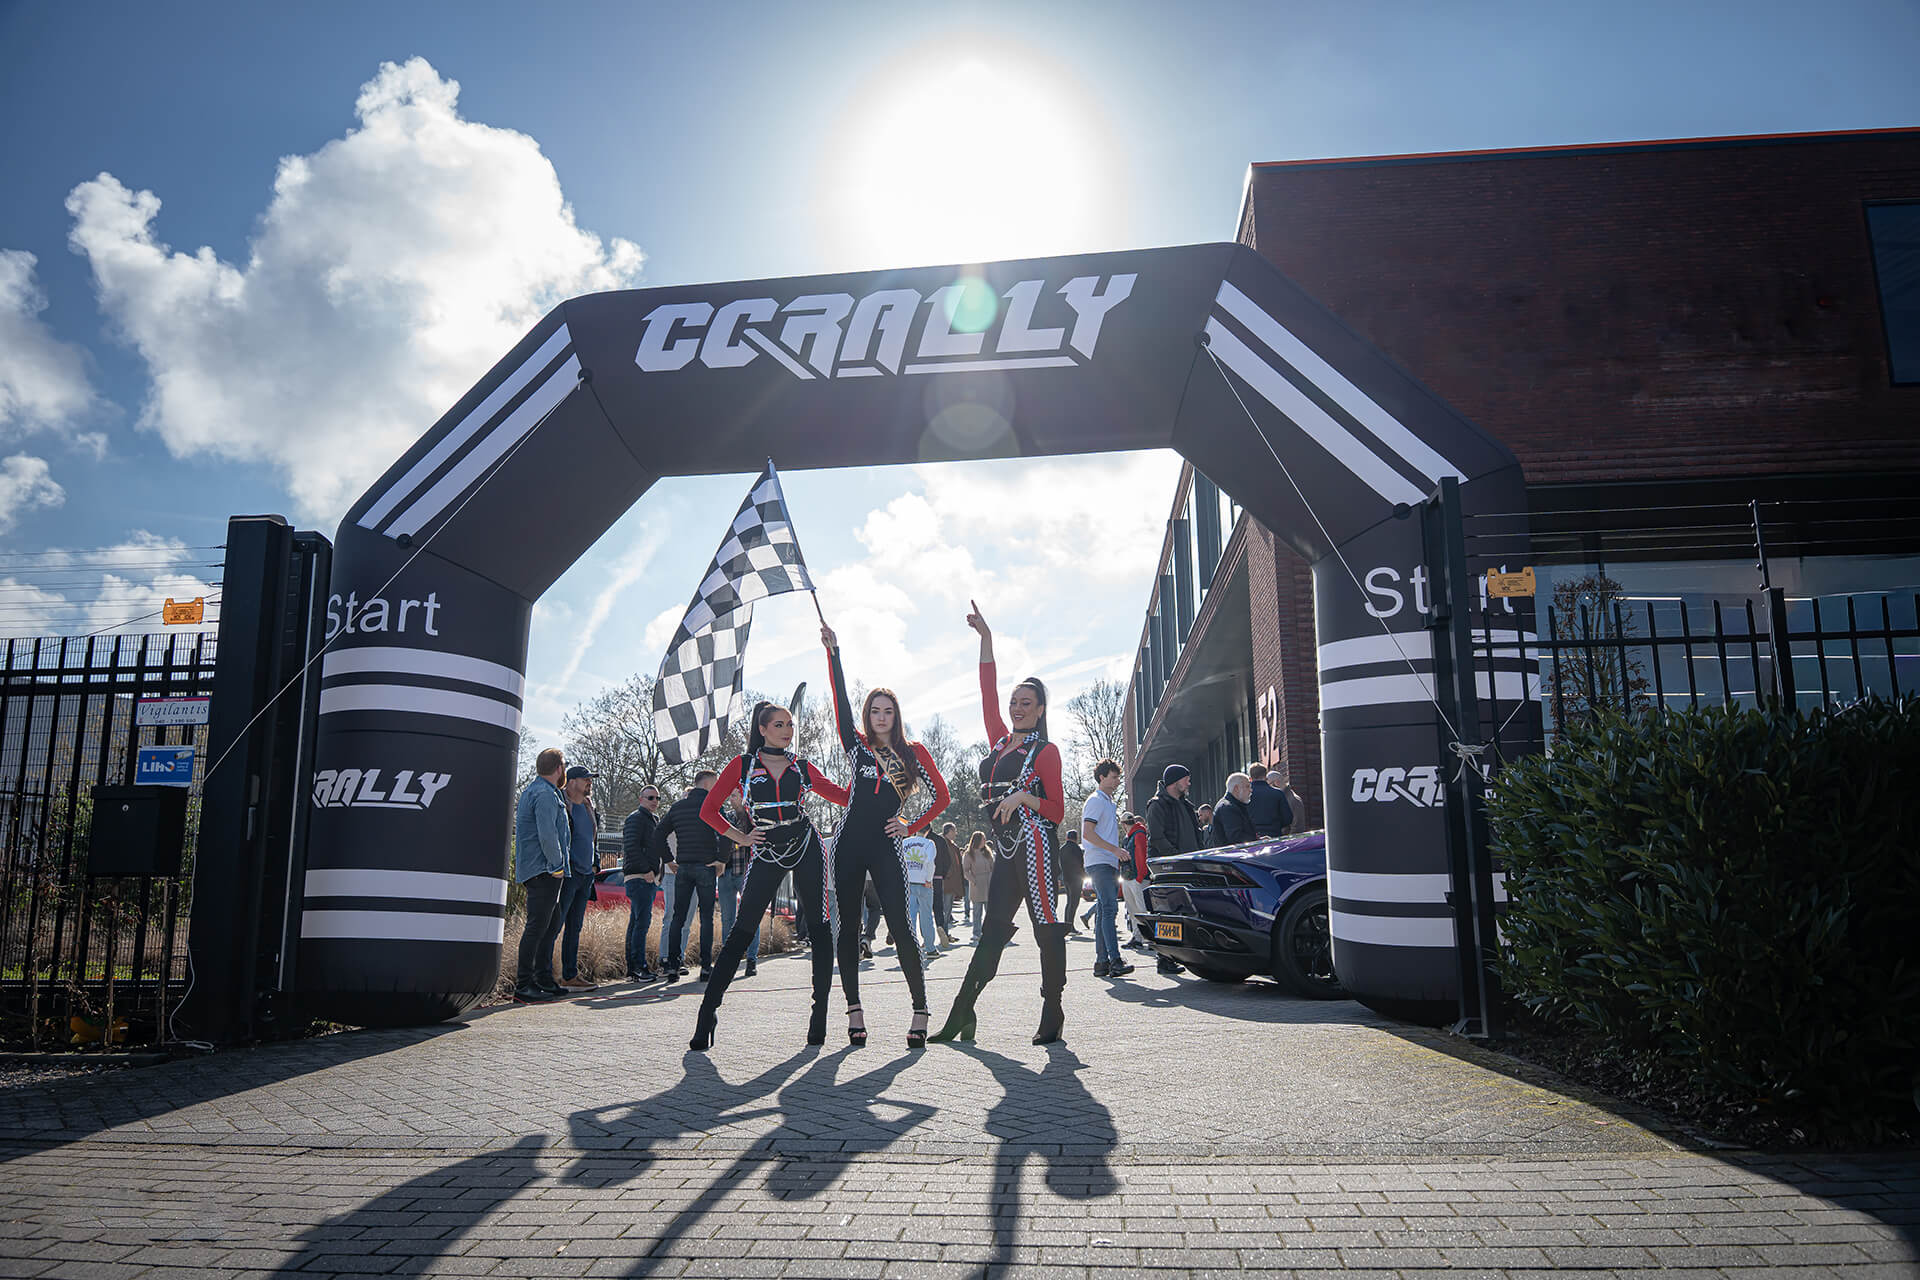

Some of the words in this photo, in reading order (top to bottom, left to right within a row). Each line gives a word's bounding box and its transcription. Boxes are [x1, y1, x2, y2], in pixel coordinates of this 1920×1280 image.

[633, 272, 1139, 381] CCRALLY
[324, 590, 442, 640] Start
[138, 702, 208, 719] Vigilantis
[1258, 685, 1281, 768] 52
